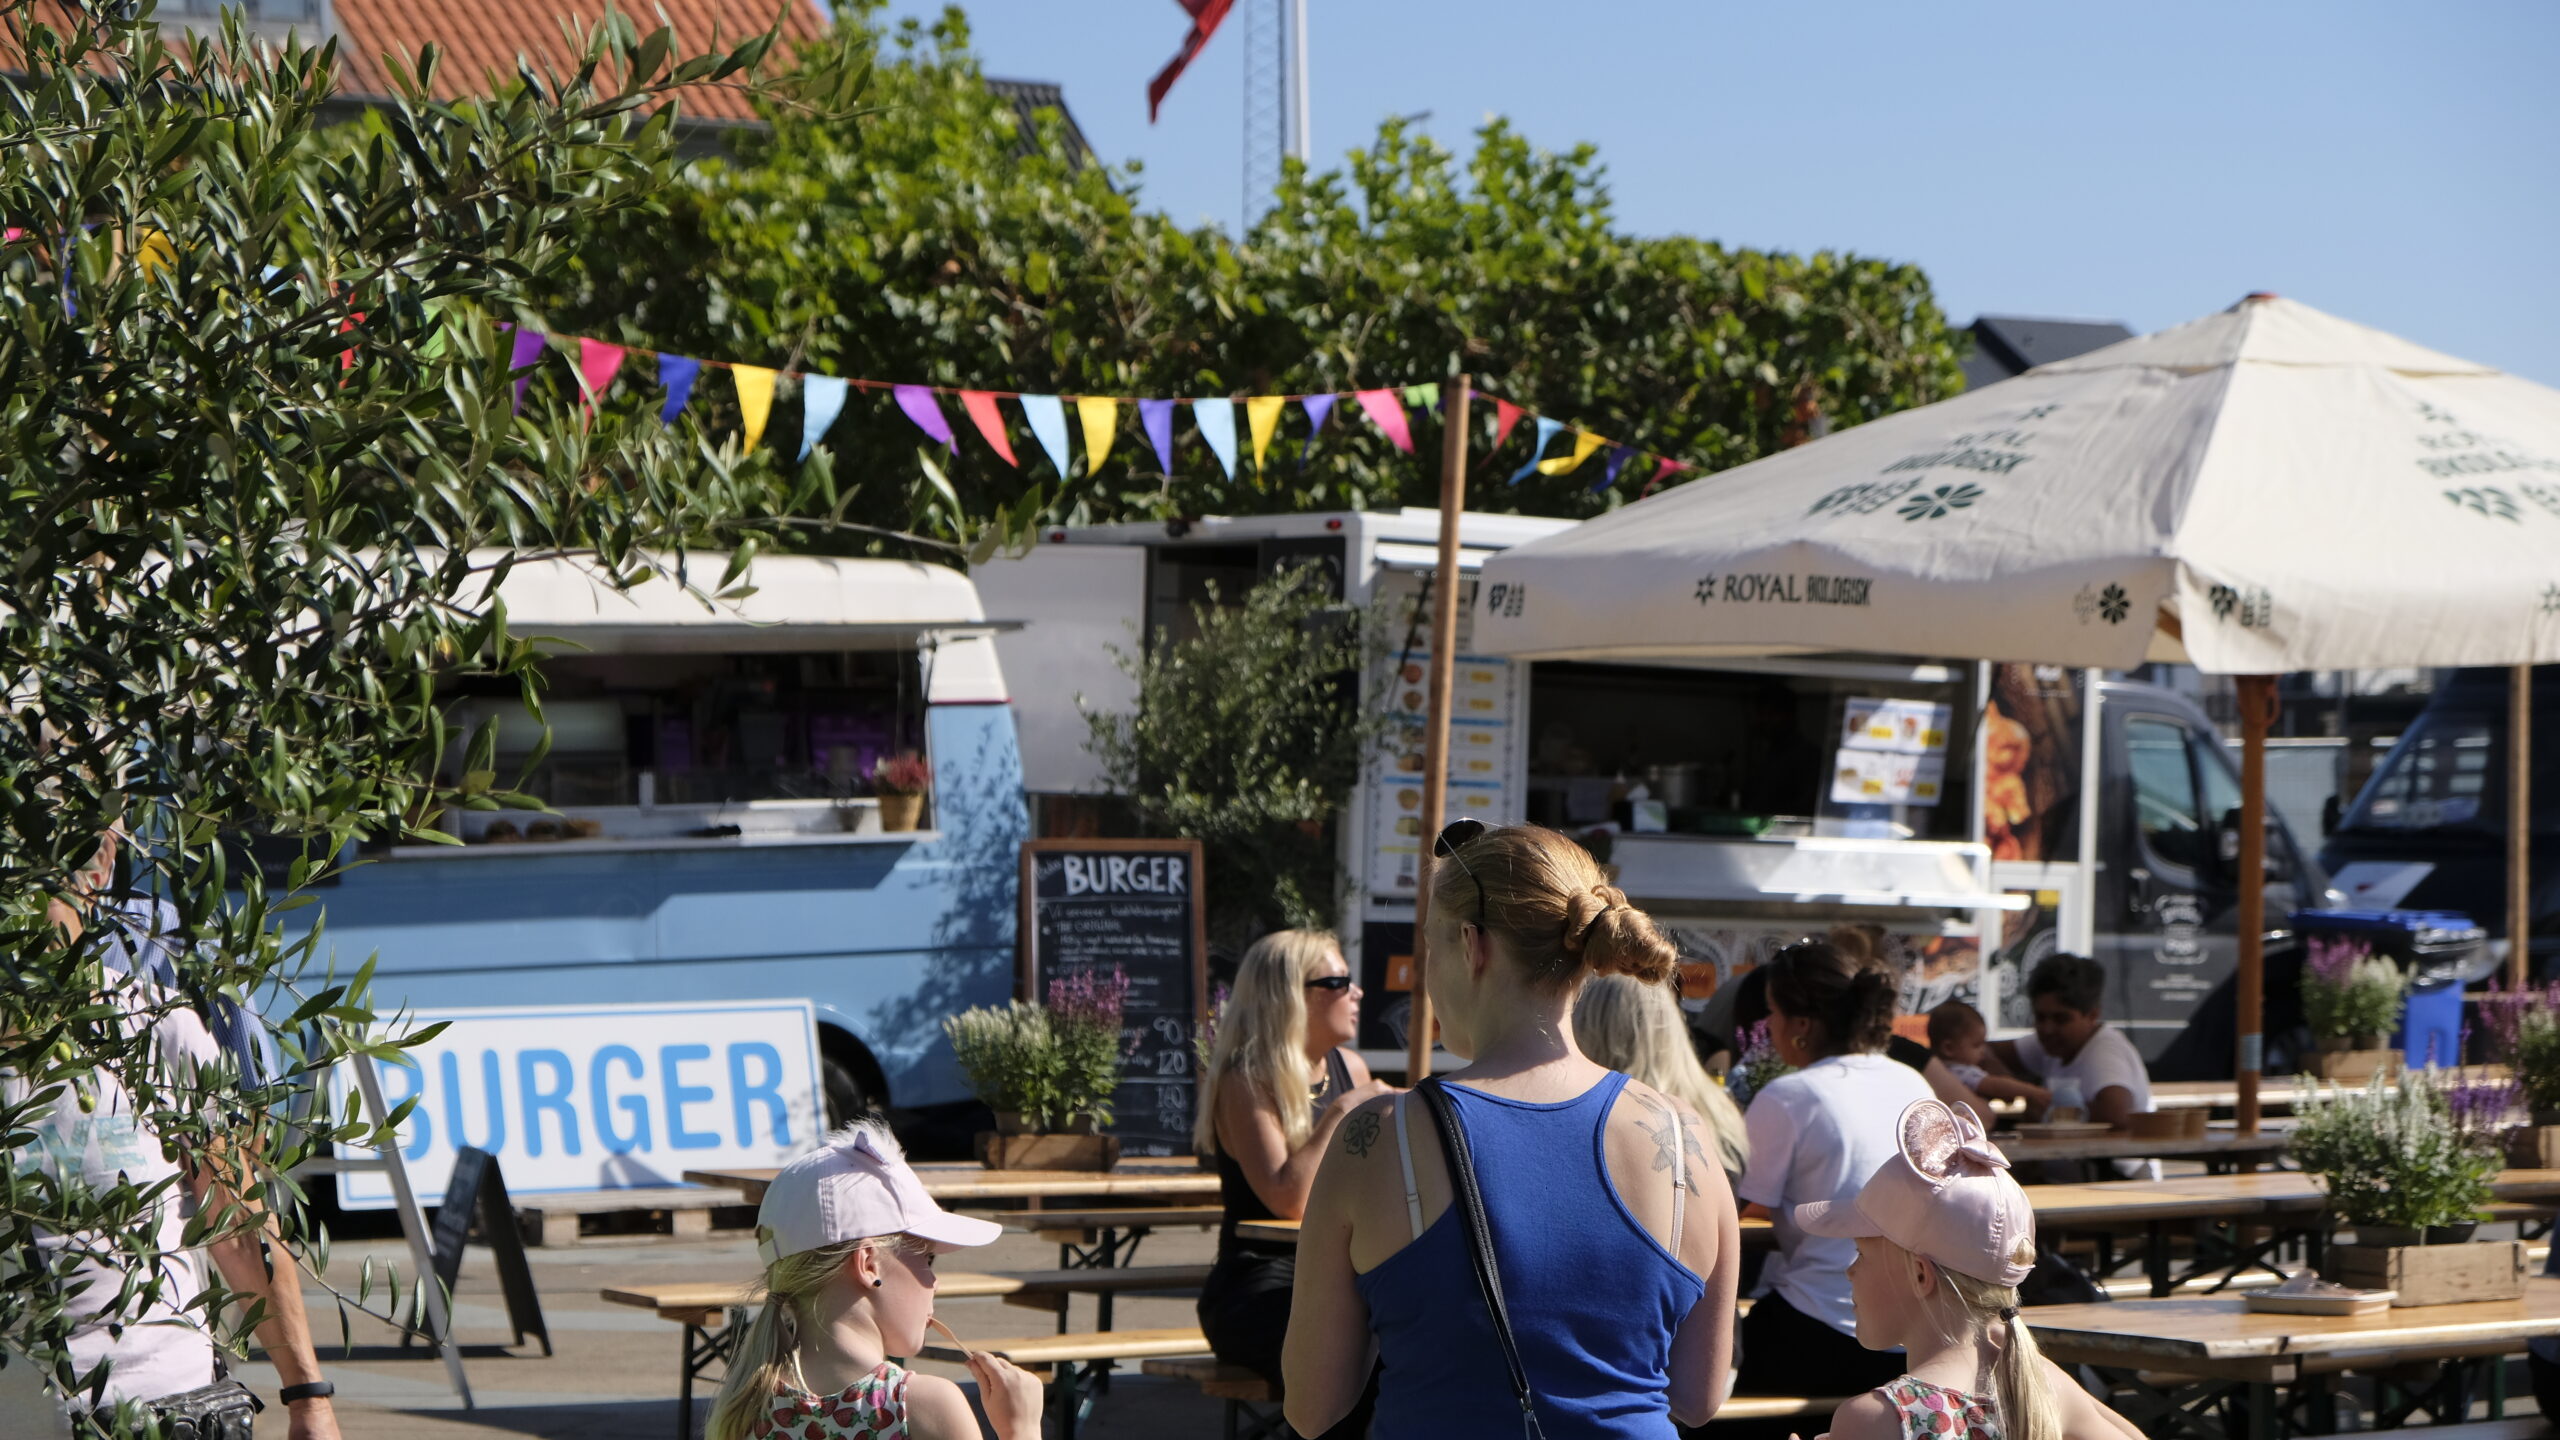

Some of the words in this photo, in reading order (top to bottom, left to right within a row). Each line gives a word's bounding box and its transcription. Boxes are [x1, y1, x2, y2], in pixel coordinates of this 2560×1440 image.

[1723, 573, 1801, 602] ROYAL
[1063, 855, 1185, 896] BURGER
[1153, 1016, 1183, 1045] 90
[1156, 1048, 1187, 1075] 120
[374, 1043, 791, 1161] BURGER
